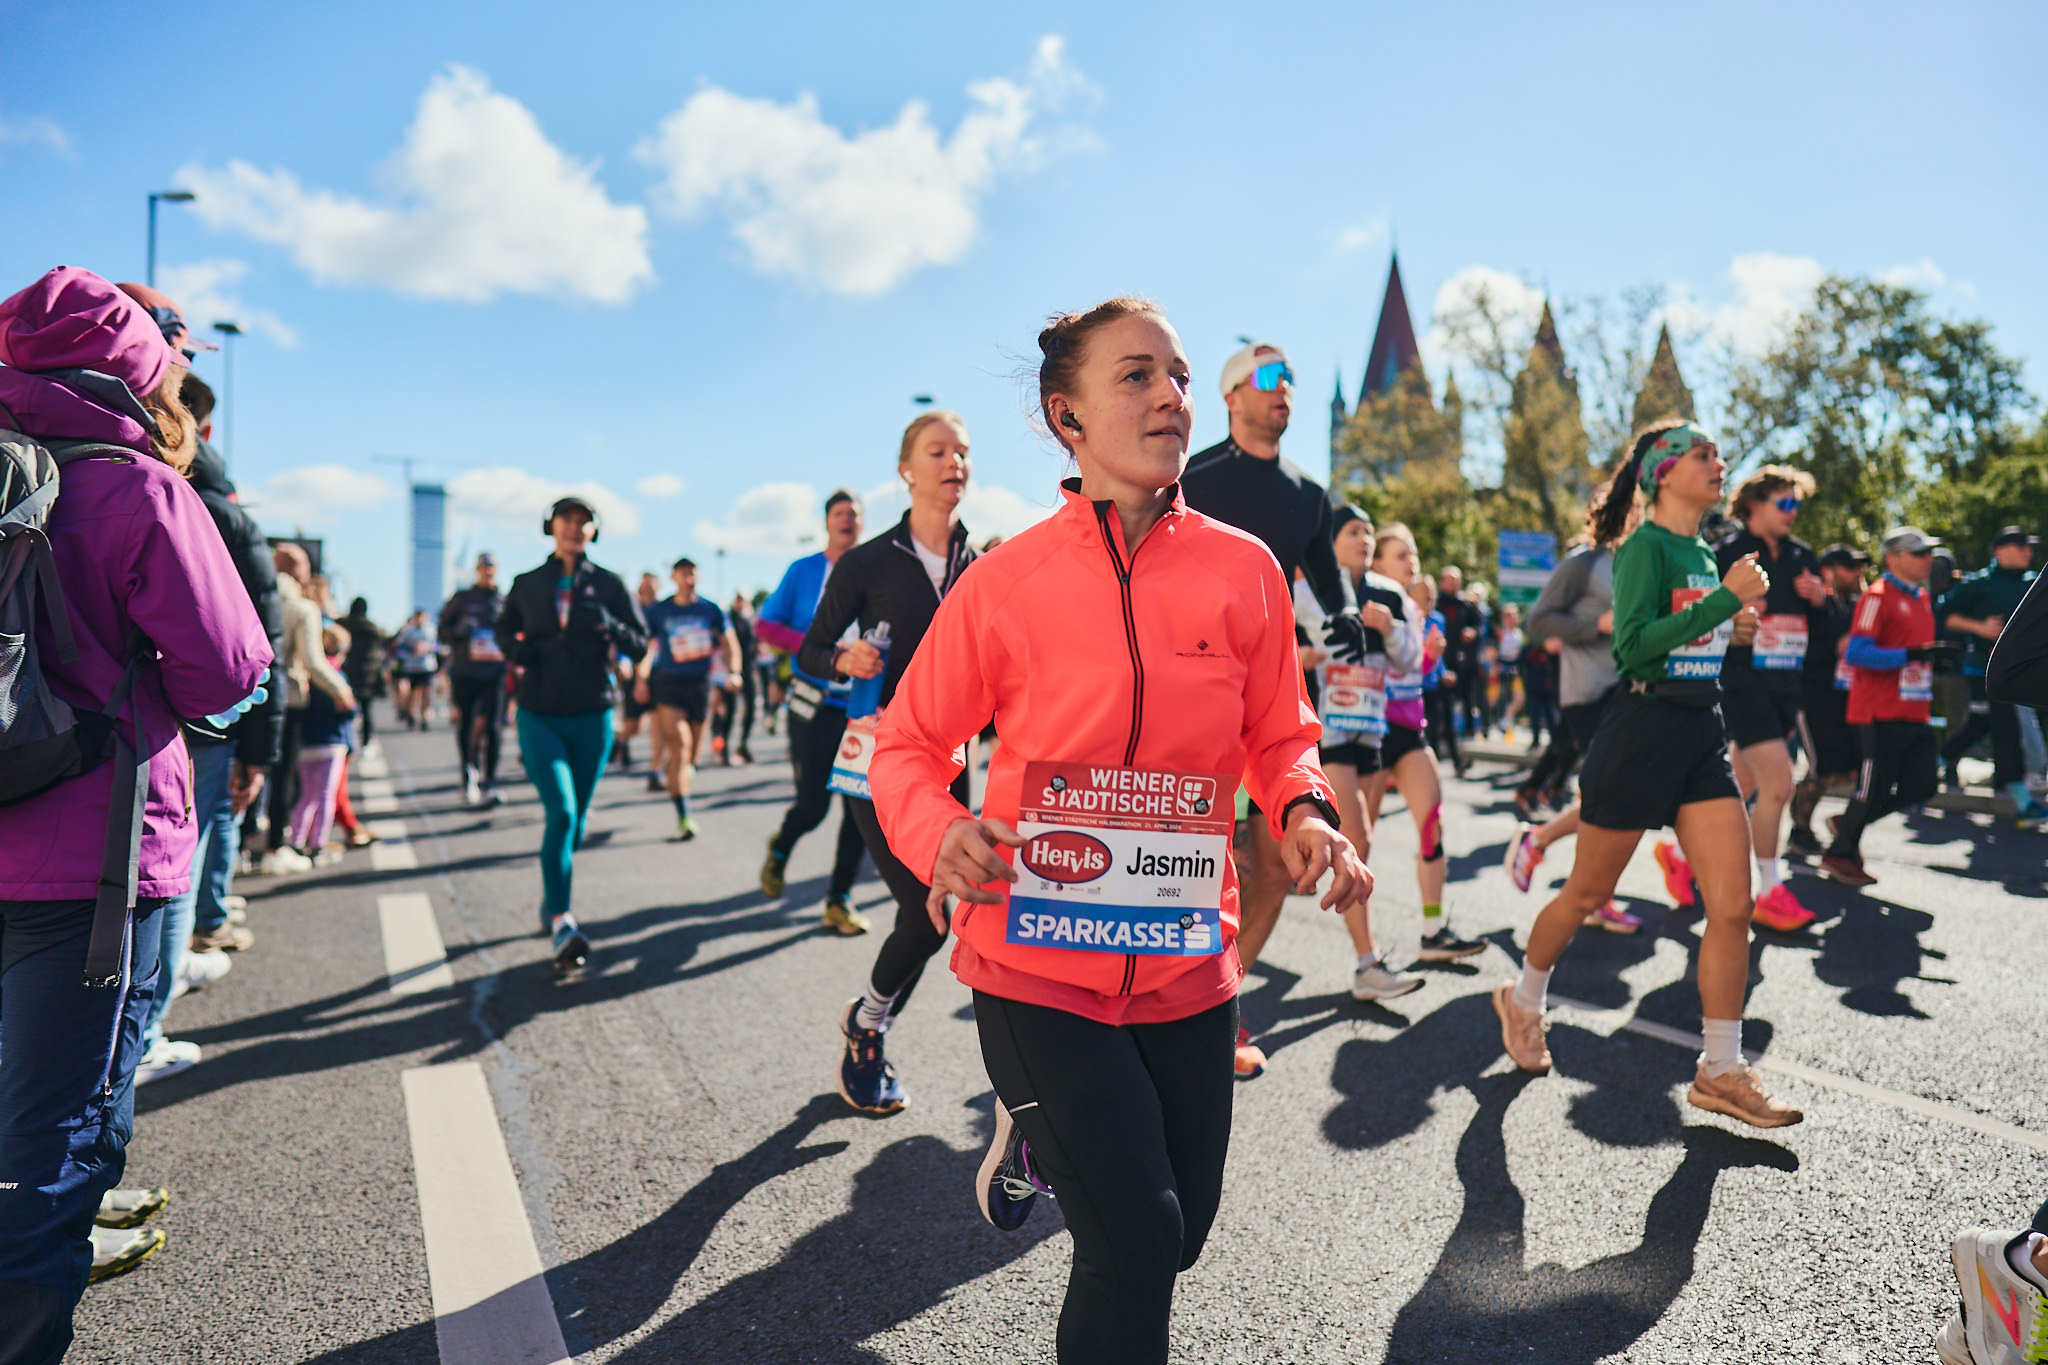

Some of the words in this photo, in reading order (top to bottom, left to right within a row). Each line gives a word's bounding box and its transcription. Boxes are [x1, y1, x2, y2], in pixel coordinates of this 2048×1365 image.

[1674, 661, 1721, 676] SPARK
[831, 773, 872, 796] SPARKA
[1090, 768, 1176, 793] WIENER
[1041, 786, 1174, 816] STÄDTISCHE
[1041, 813, 1064, 822] WIENER
[1030, 839, 1105, 874] Hervis
[1126, 846, 1215, 878] Jasmin
[1156, 887, 1181, 898] 20692
[1017, 912, 1181, 949] SPARKASSE
